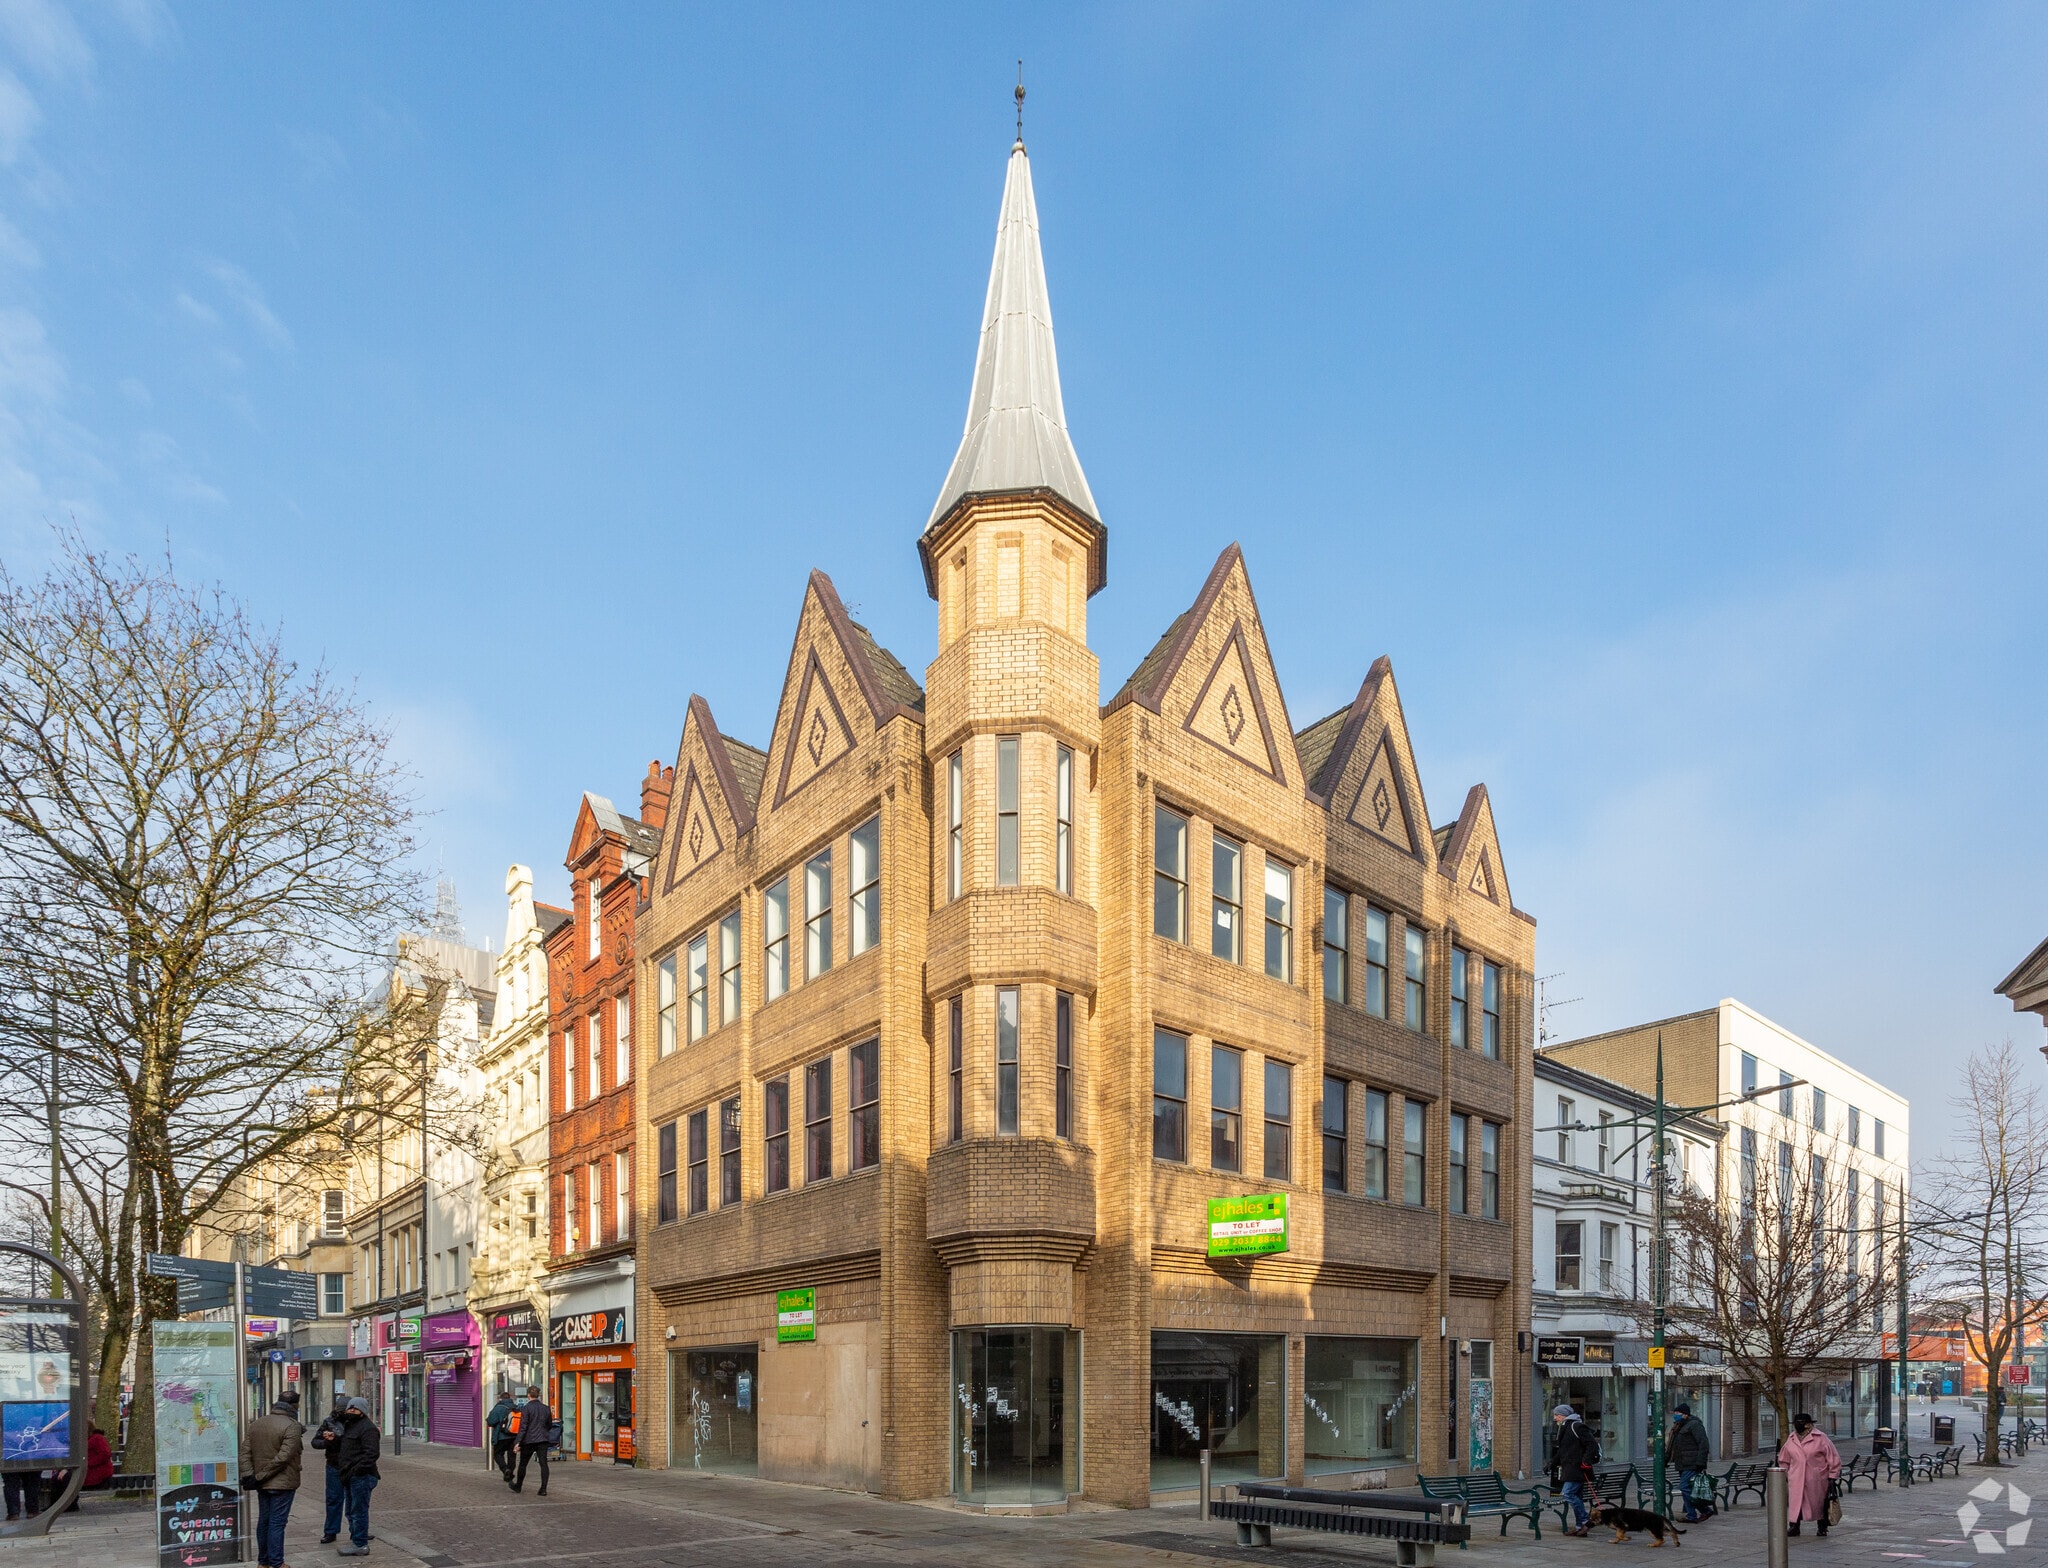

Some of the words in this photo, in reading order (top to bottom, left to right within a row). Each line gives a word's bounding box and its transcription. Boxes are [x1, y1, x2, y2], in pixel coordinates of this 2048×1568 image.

[1213, 1201, 1263, 1219] ejhales
[1212, 1238, 1230, 1247] 029
[1232, 1237, 1255, 1245] 2037
[1257, 1235, 1282, 1243] 8844
[1218, 1245, 1275, 1253] www.ejhales.co.uk
[1555, 1341, 1579, 1349] Repairs
[1541, 1353, 1553, 1361] Key
[1553, 1353, 1576, 1361] Cutting
[168, 1514, 234, 1530] Generation
